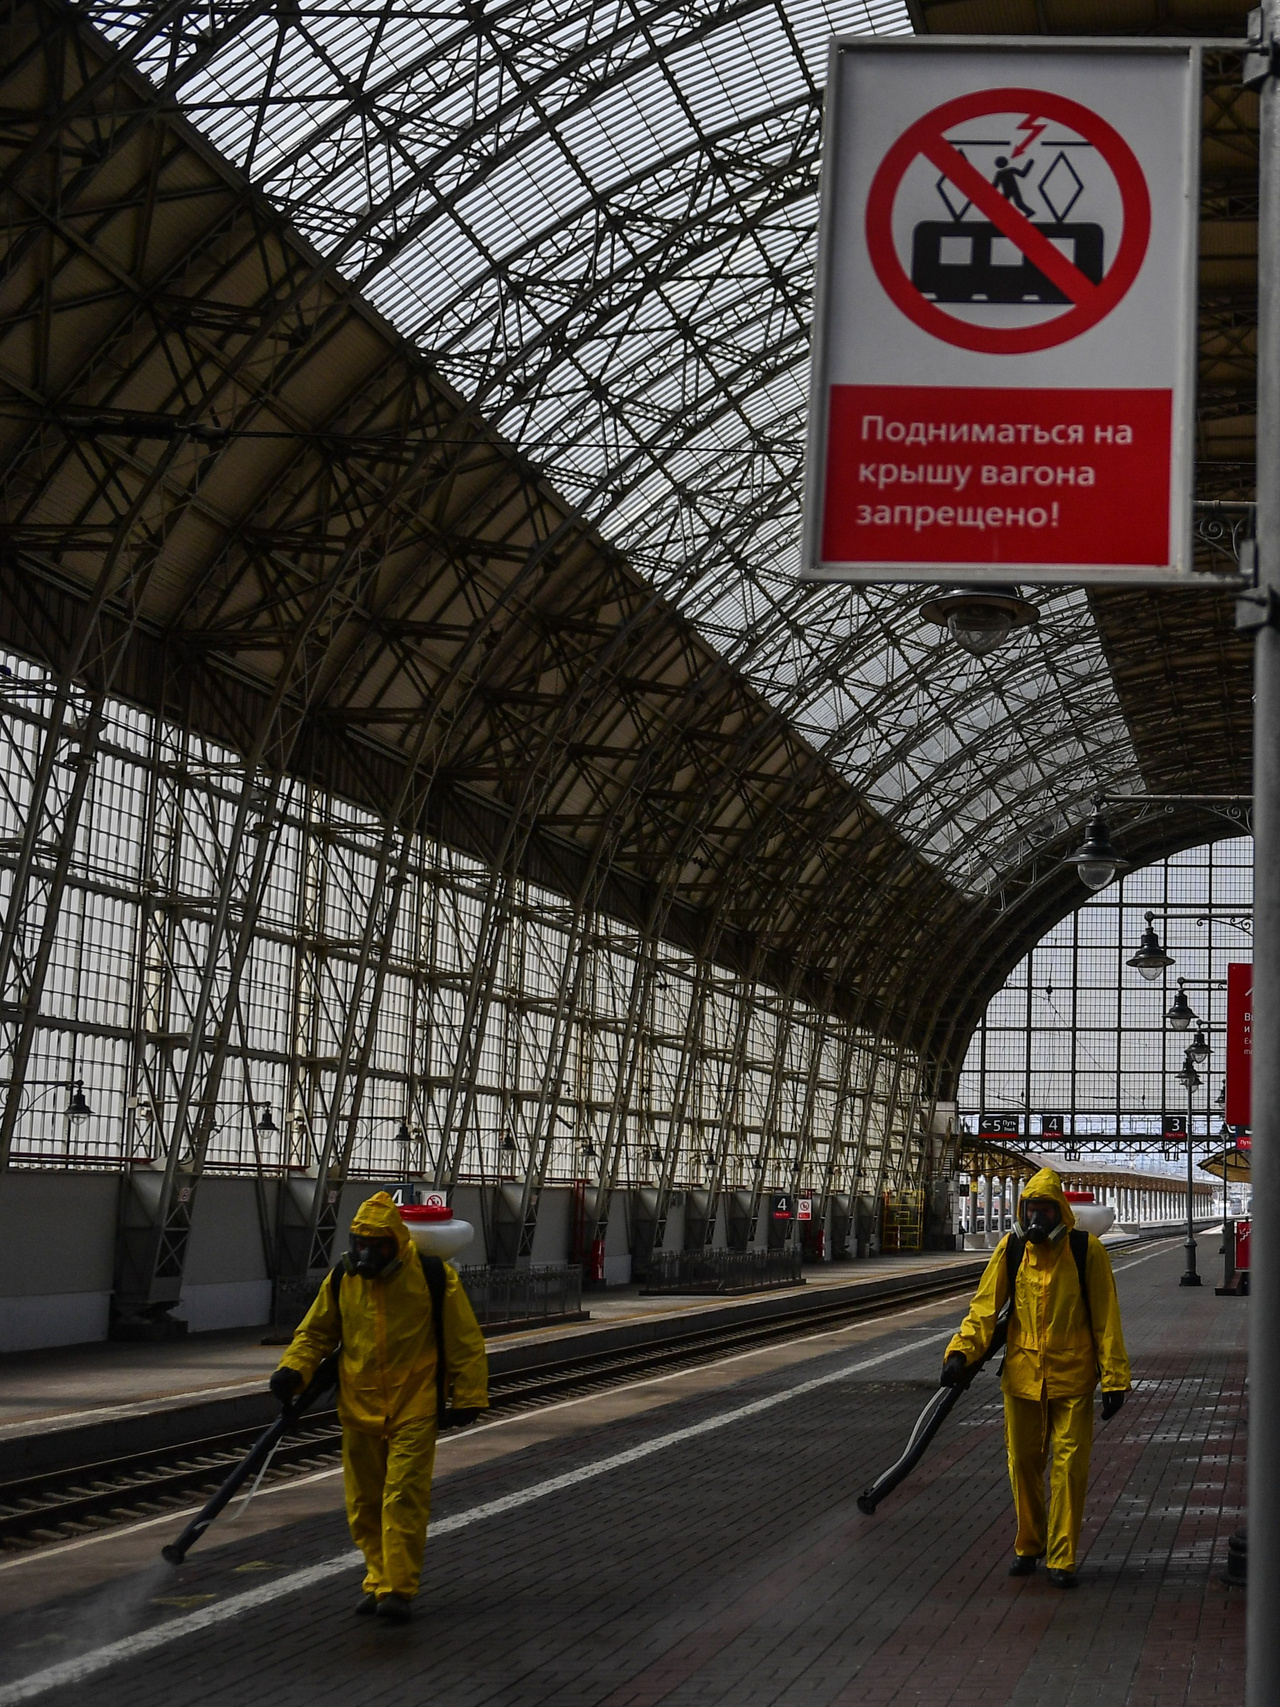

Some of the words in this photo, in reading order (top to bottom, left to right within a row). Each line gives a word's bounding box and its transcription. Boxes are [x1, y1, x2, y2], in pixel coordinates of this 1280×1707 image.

[861, 415, 1084, 446] Подниматься
[1094, 424, 1134, 445] на
[859, 463, 973, 491] крышу
[981, 465, 1096, 486] вагона
[856, 501, 1060, 532] запрещено!
[993, 1120, 1001, 1132] 5
[1048, 1118, 1058, 1131] 4
[1171, 1118, 1180, 1131] 3
[392, 1189, 405, 1206] 4
[777, 1198, 787, 1211] 4
